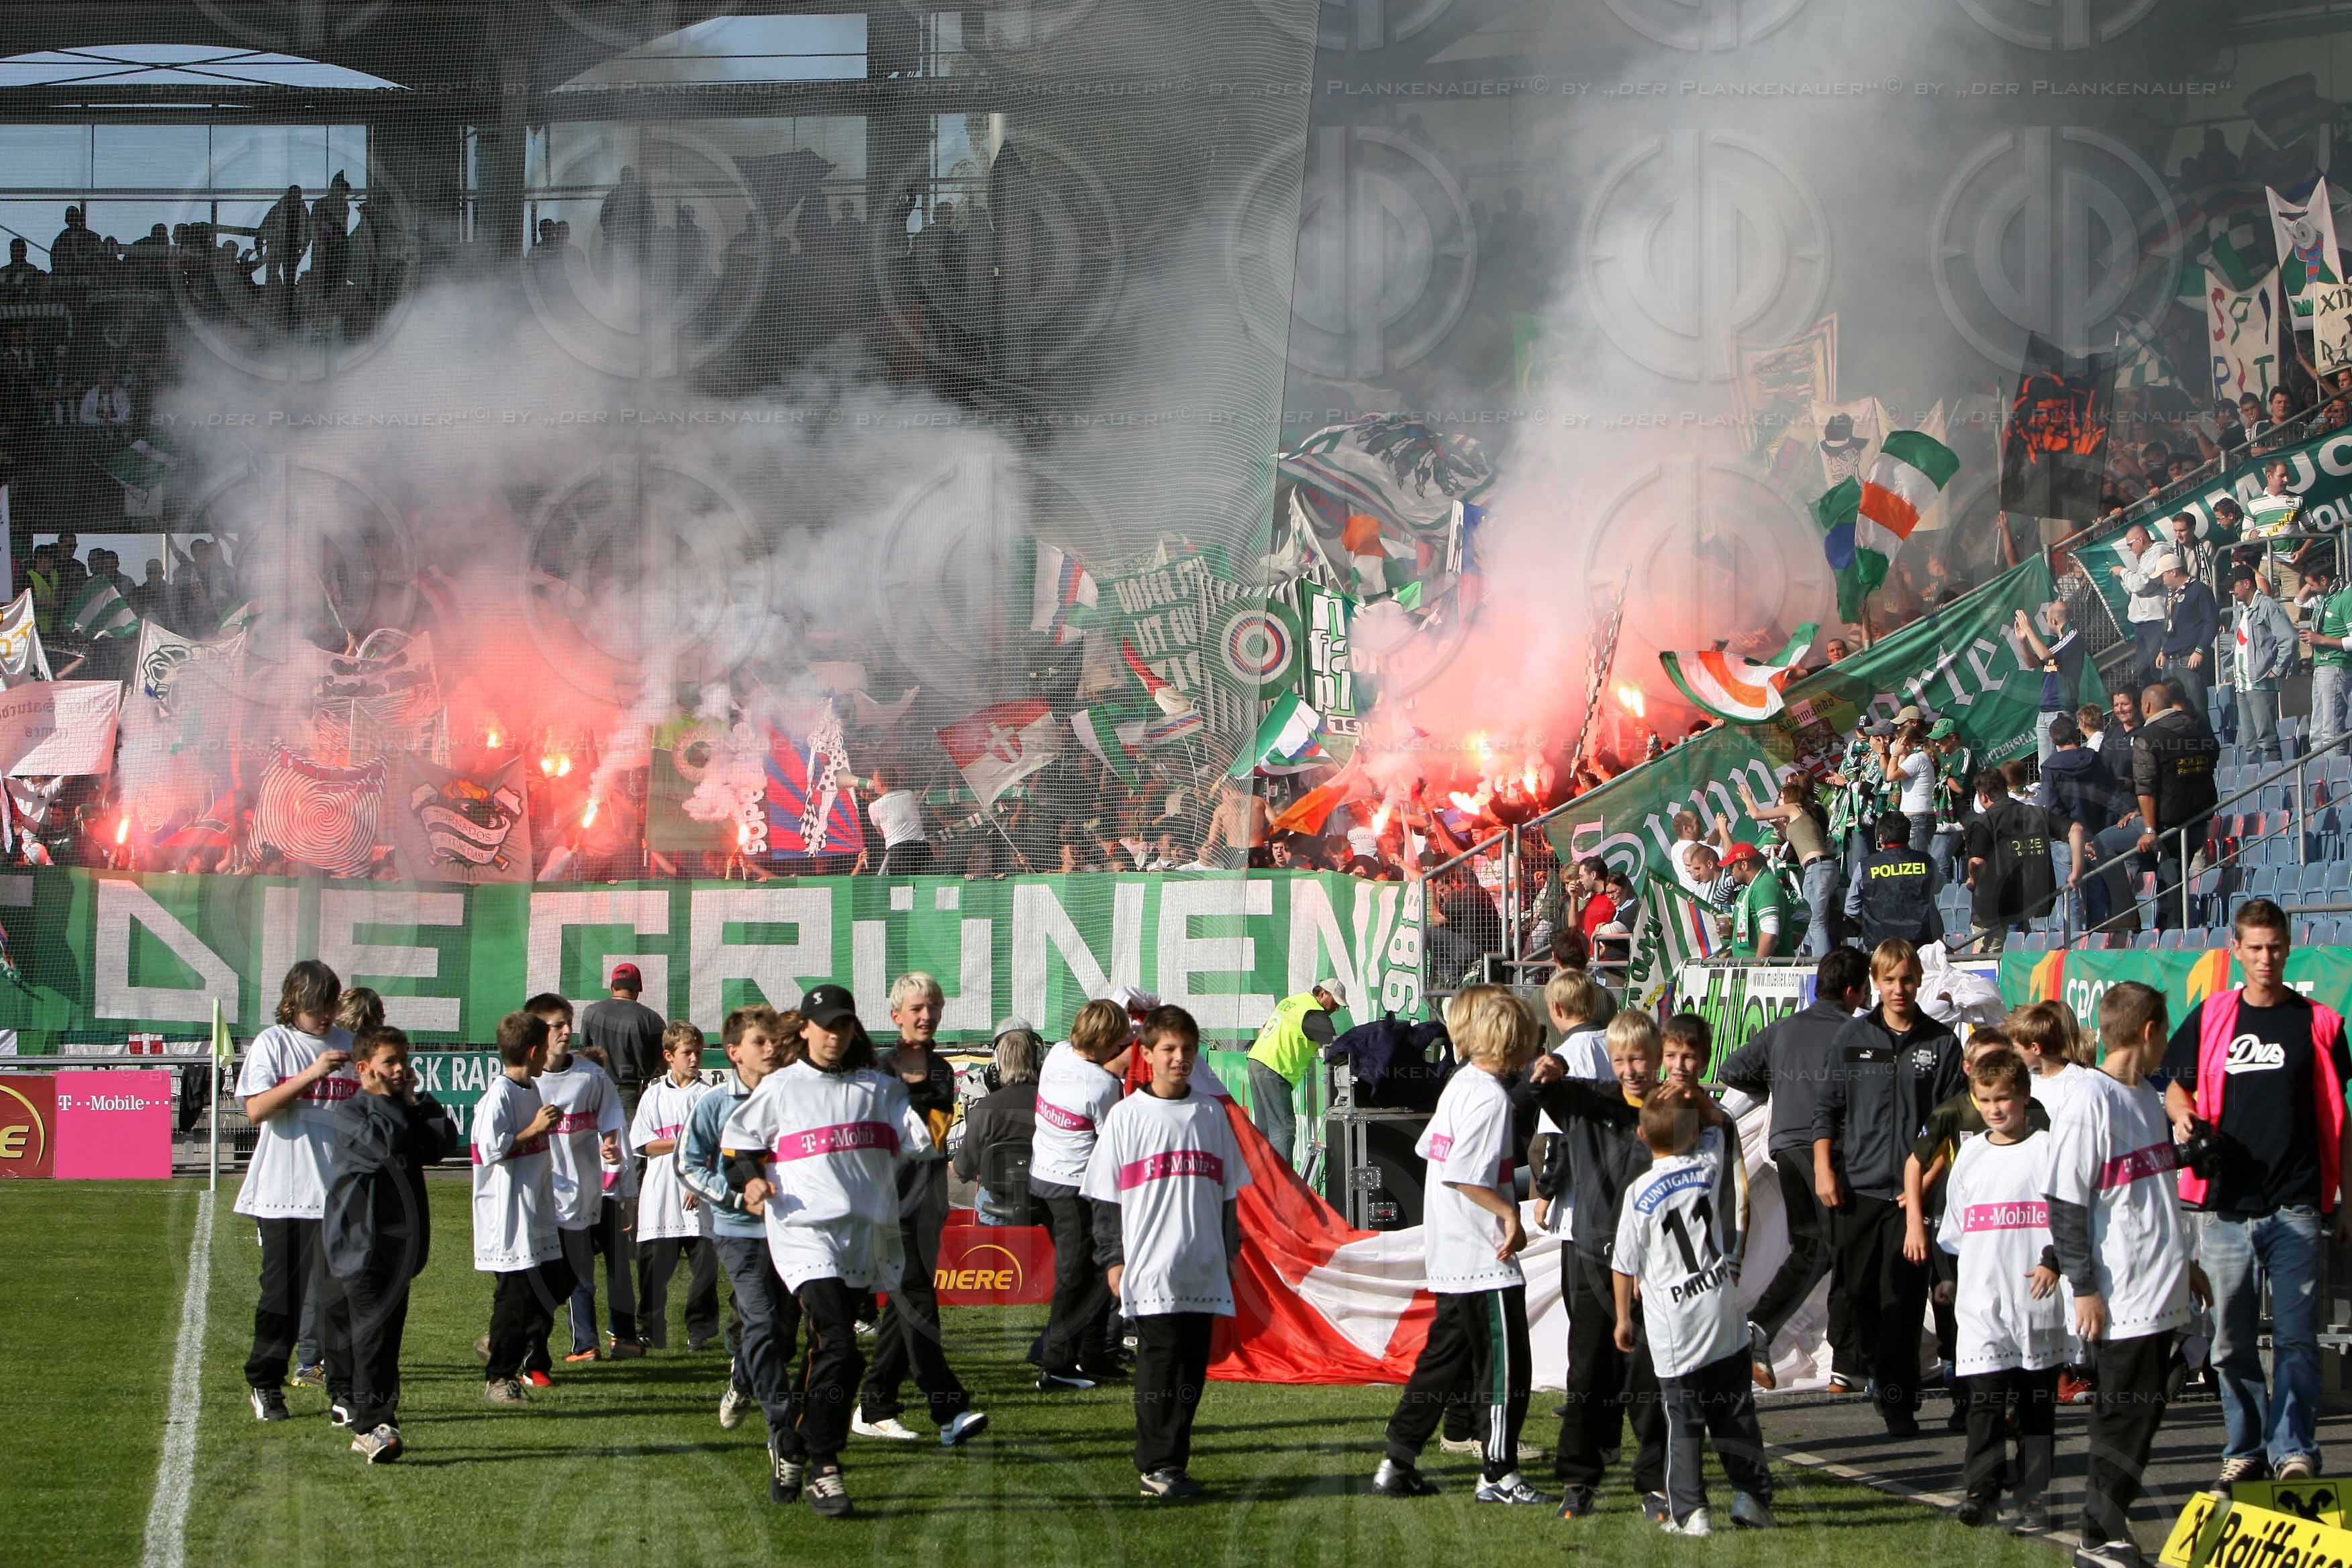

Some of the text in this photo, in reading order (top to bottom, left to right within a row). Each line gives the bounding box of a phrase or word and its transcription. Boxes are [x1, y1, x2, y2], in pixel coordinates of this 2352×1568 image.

[1870, 863, 1926, 879] POLIZEI
[411, 1057, 505, 1092] SK RAP
[1661, 1195, 1724, 1275] 11
